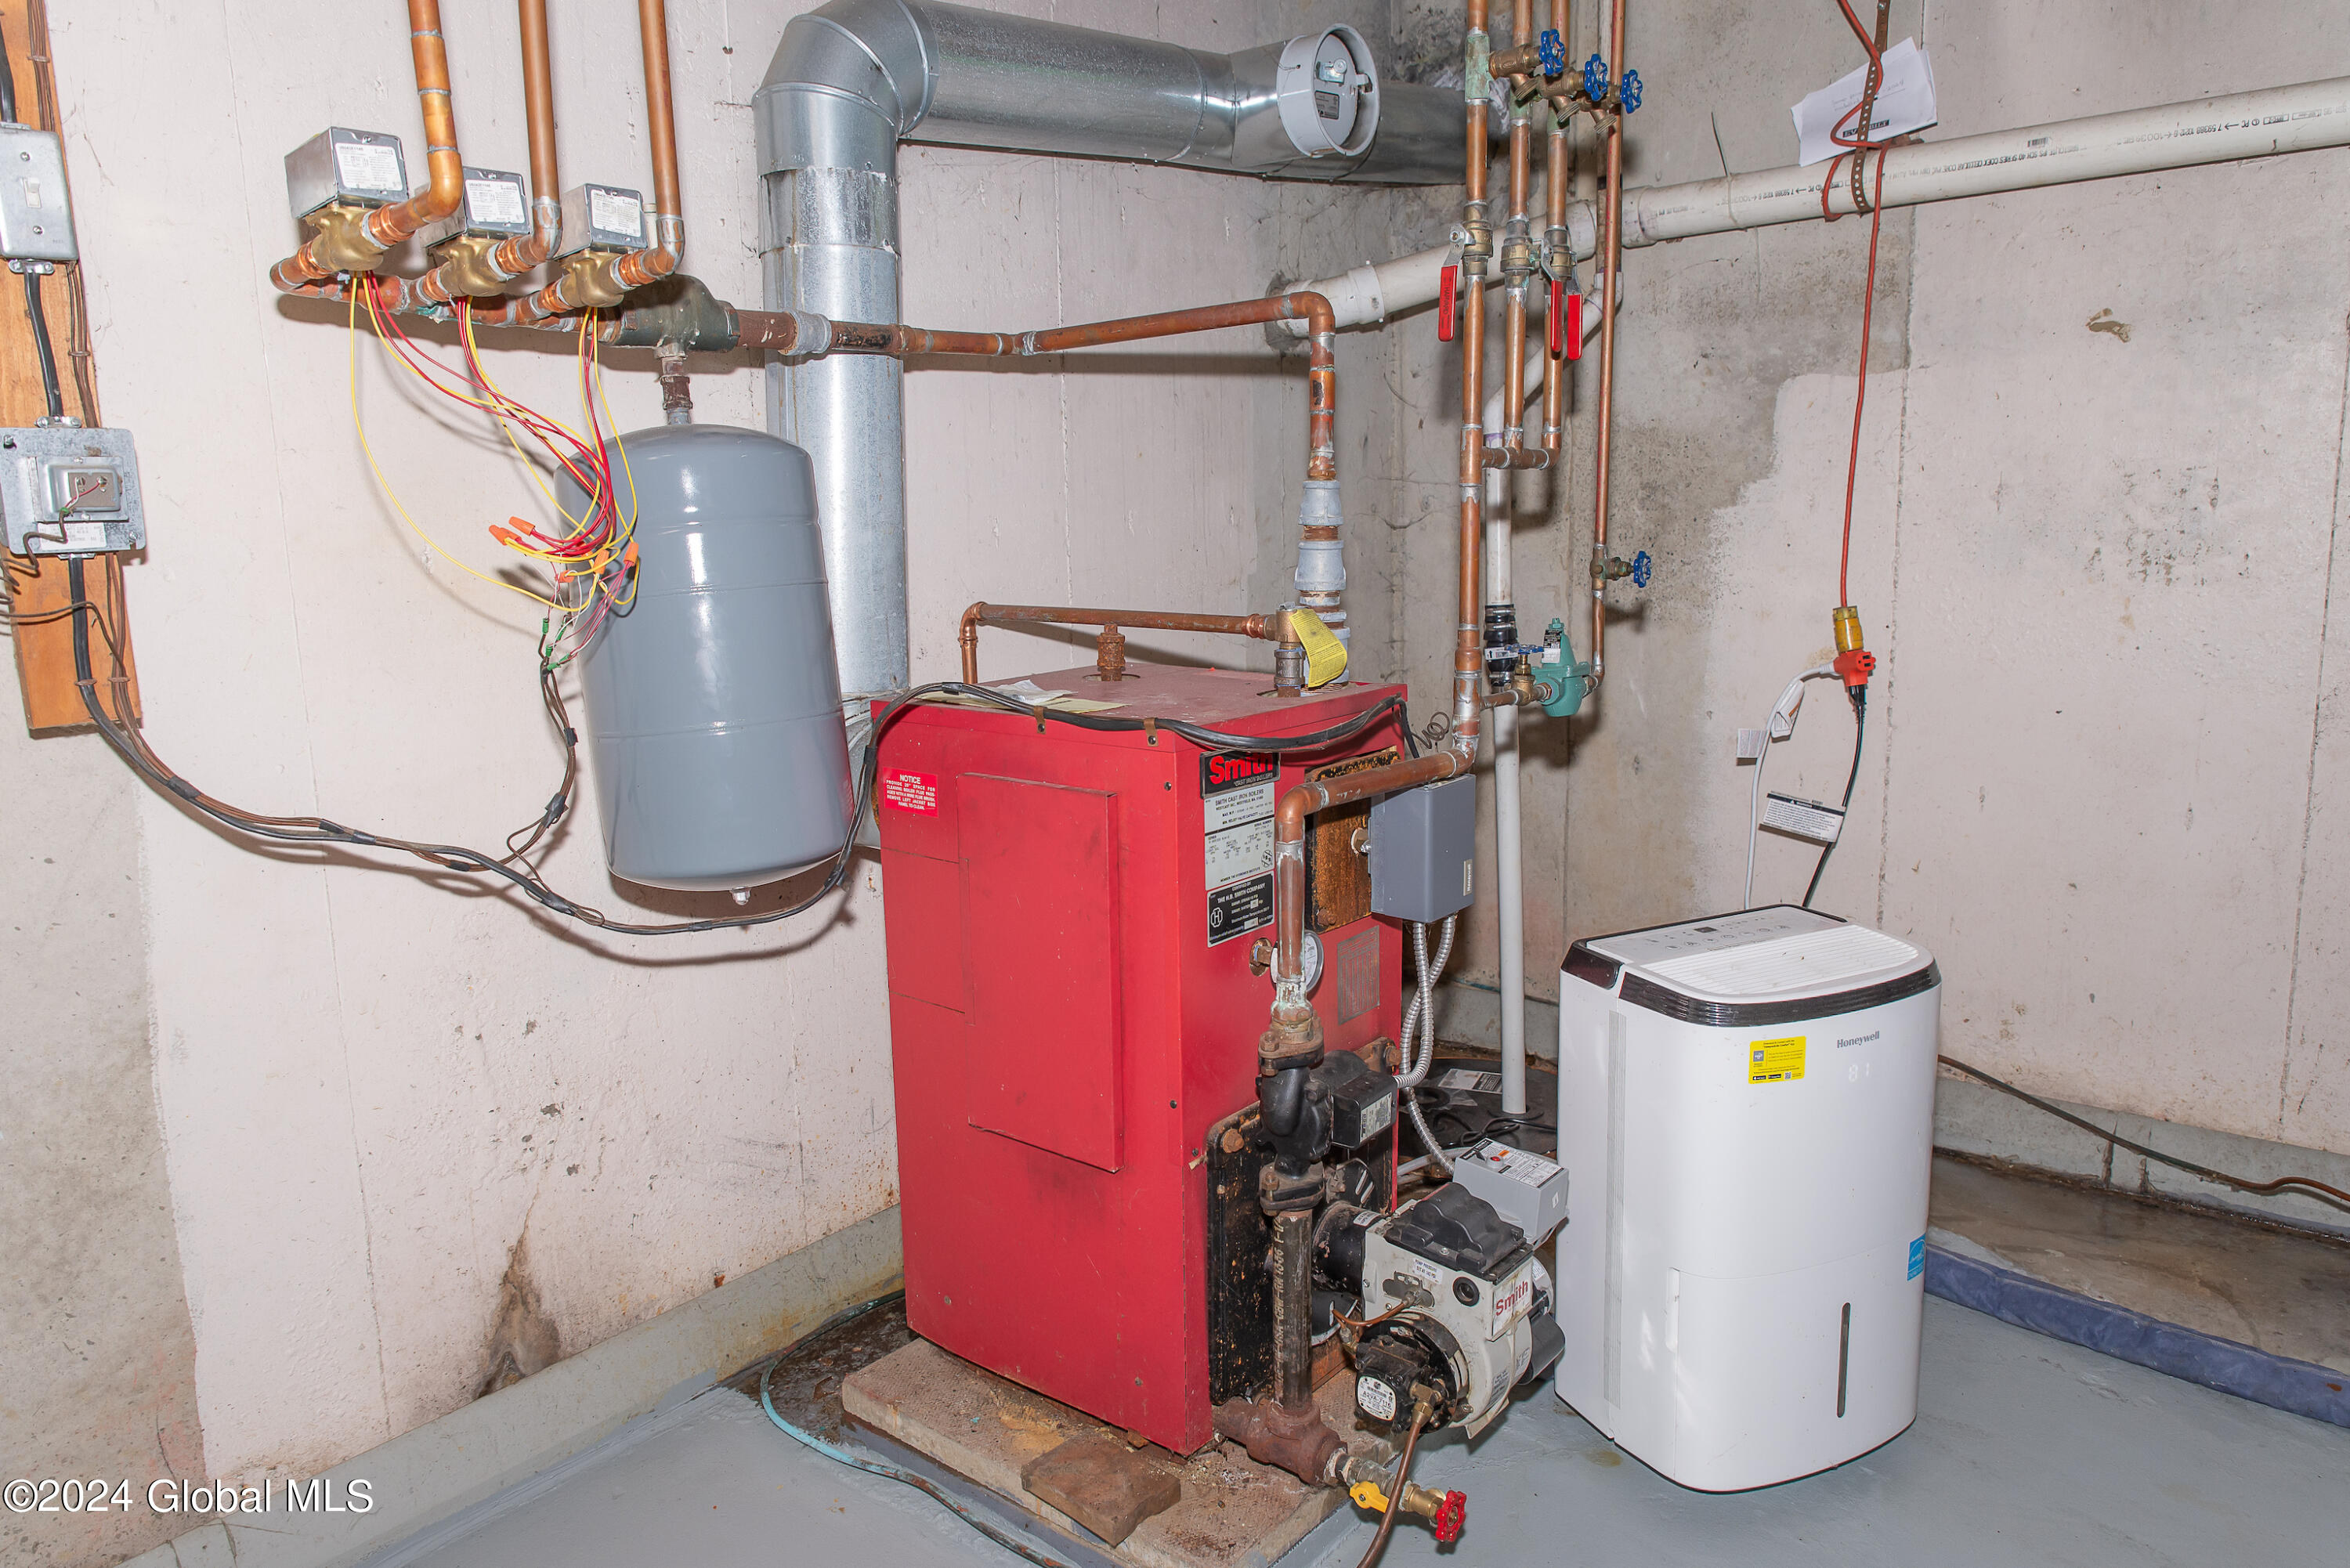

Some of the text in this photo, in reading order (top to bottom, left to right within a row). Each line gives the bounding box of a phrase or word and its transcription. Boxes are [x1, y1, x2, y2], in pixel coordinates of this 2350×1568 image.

[1209, 752, 1273, 784] Smith
[899, 774, 921, 784] NOTICE
[1248, 789, 1264, 797] BOILERS
[1217, 895, 1226, 904] THE
[1246, 882, 1266, 894] COMPANY
[1837, 1030, 1880, 1049] Honeywell
[1495, 1281, 1528, 1317] Smith
